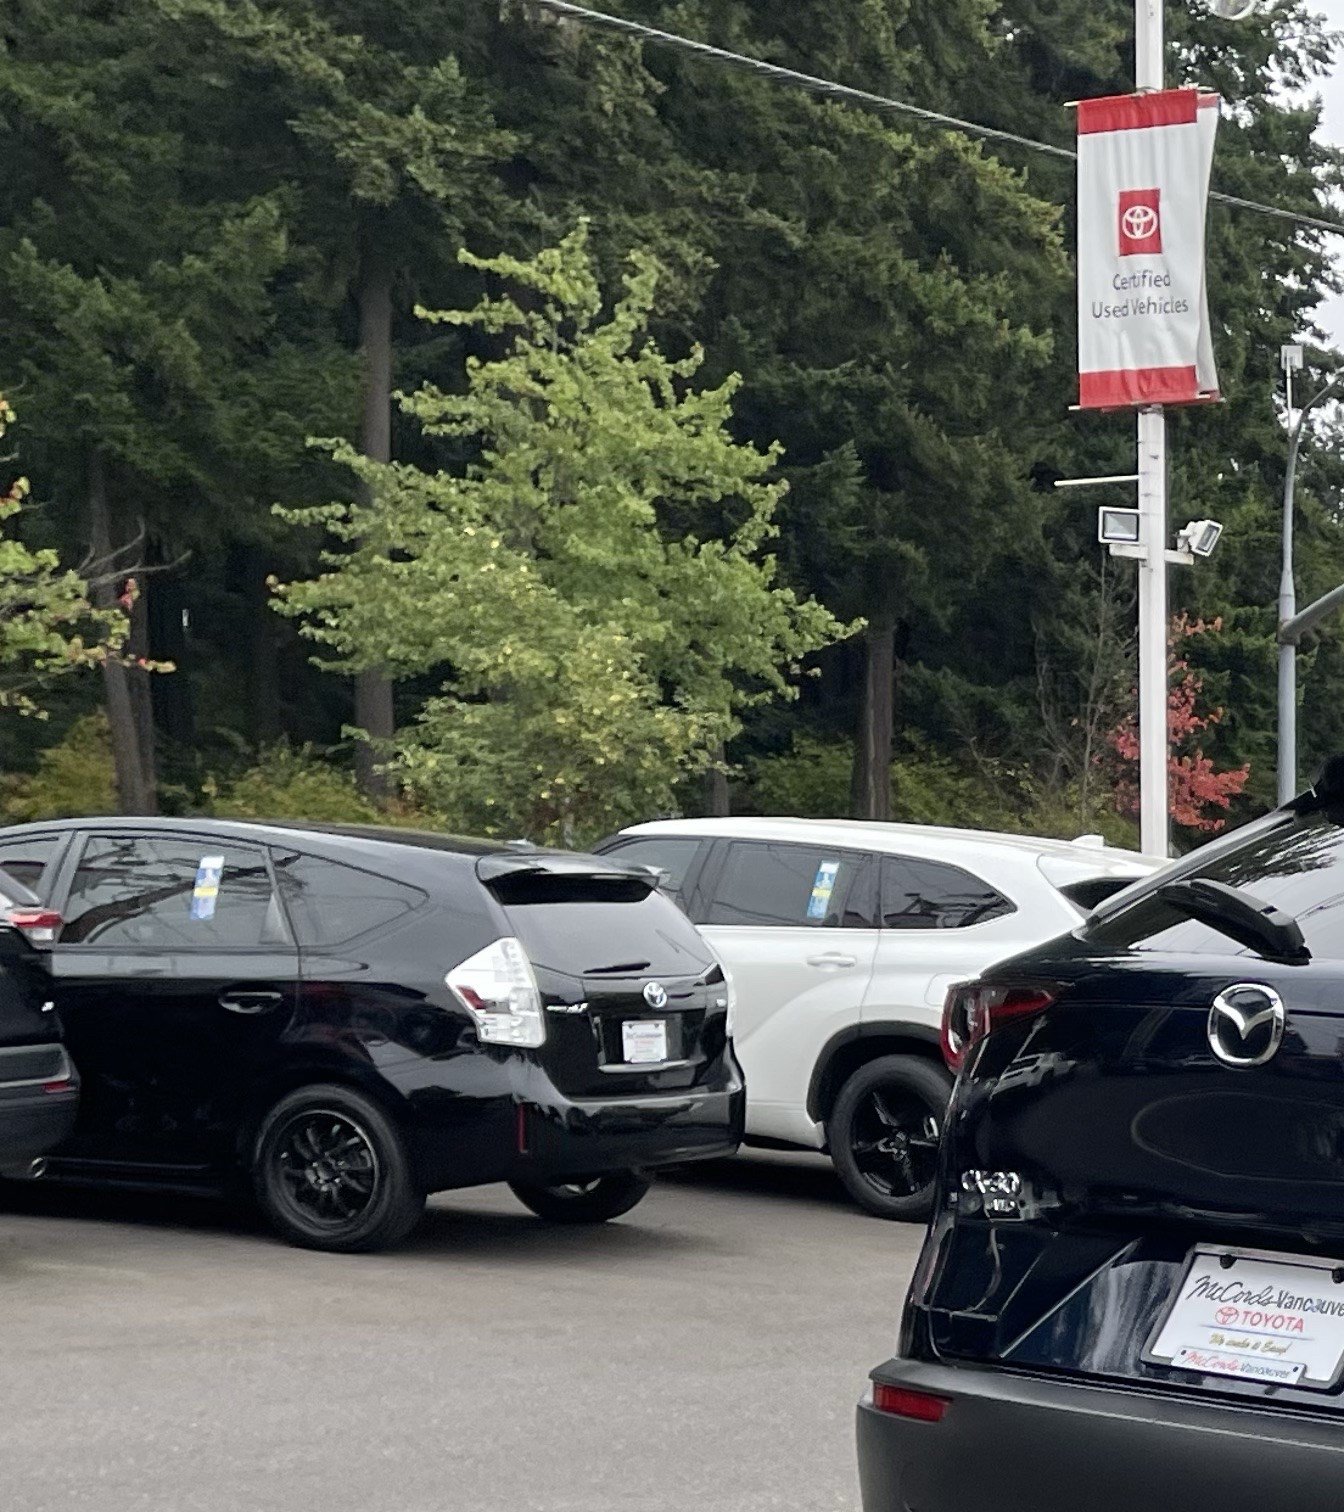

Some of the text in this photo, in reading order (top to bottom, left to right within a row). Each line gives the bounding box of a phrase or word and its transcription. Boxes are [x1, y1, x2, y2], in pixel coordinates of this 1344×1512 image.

[1113, 270, 1171, 291] Certified
[1092, 297, 1189, 319] Used Vehicles
[1242, 1310, 1305, 1333] TOYOTA
